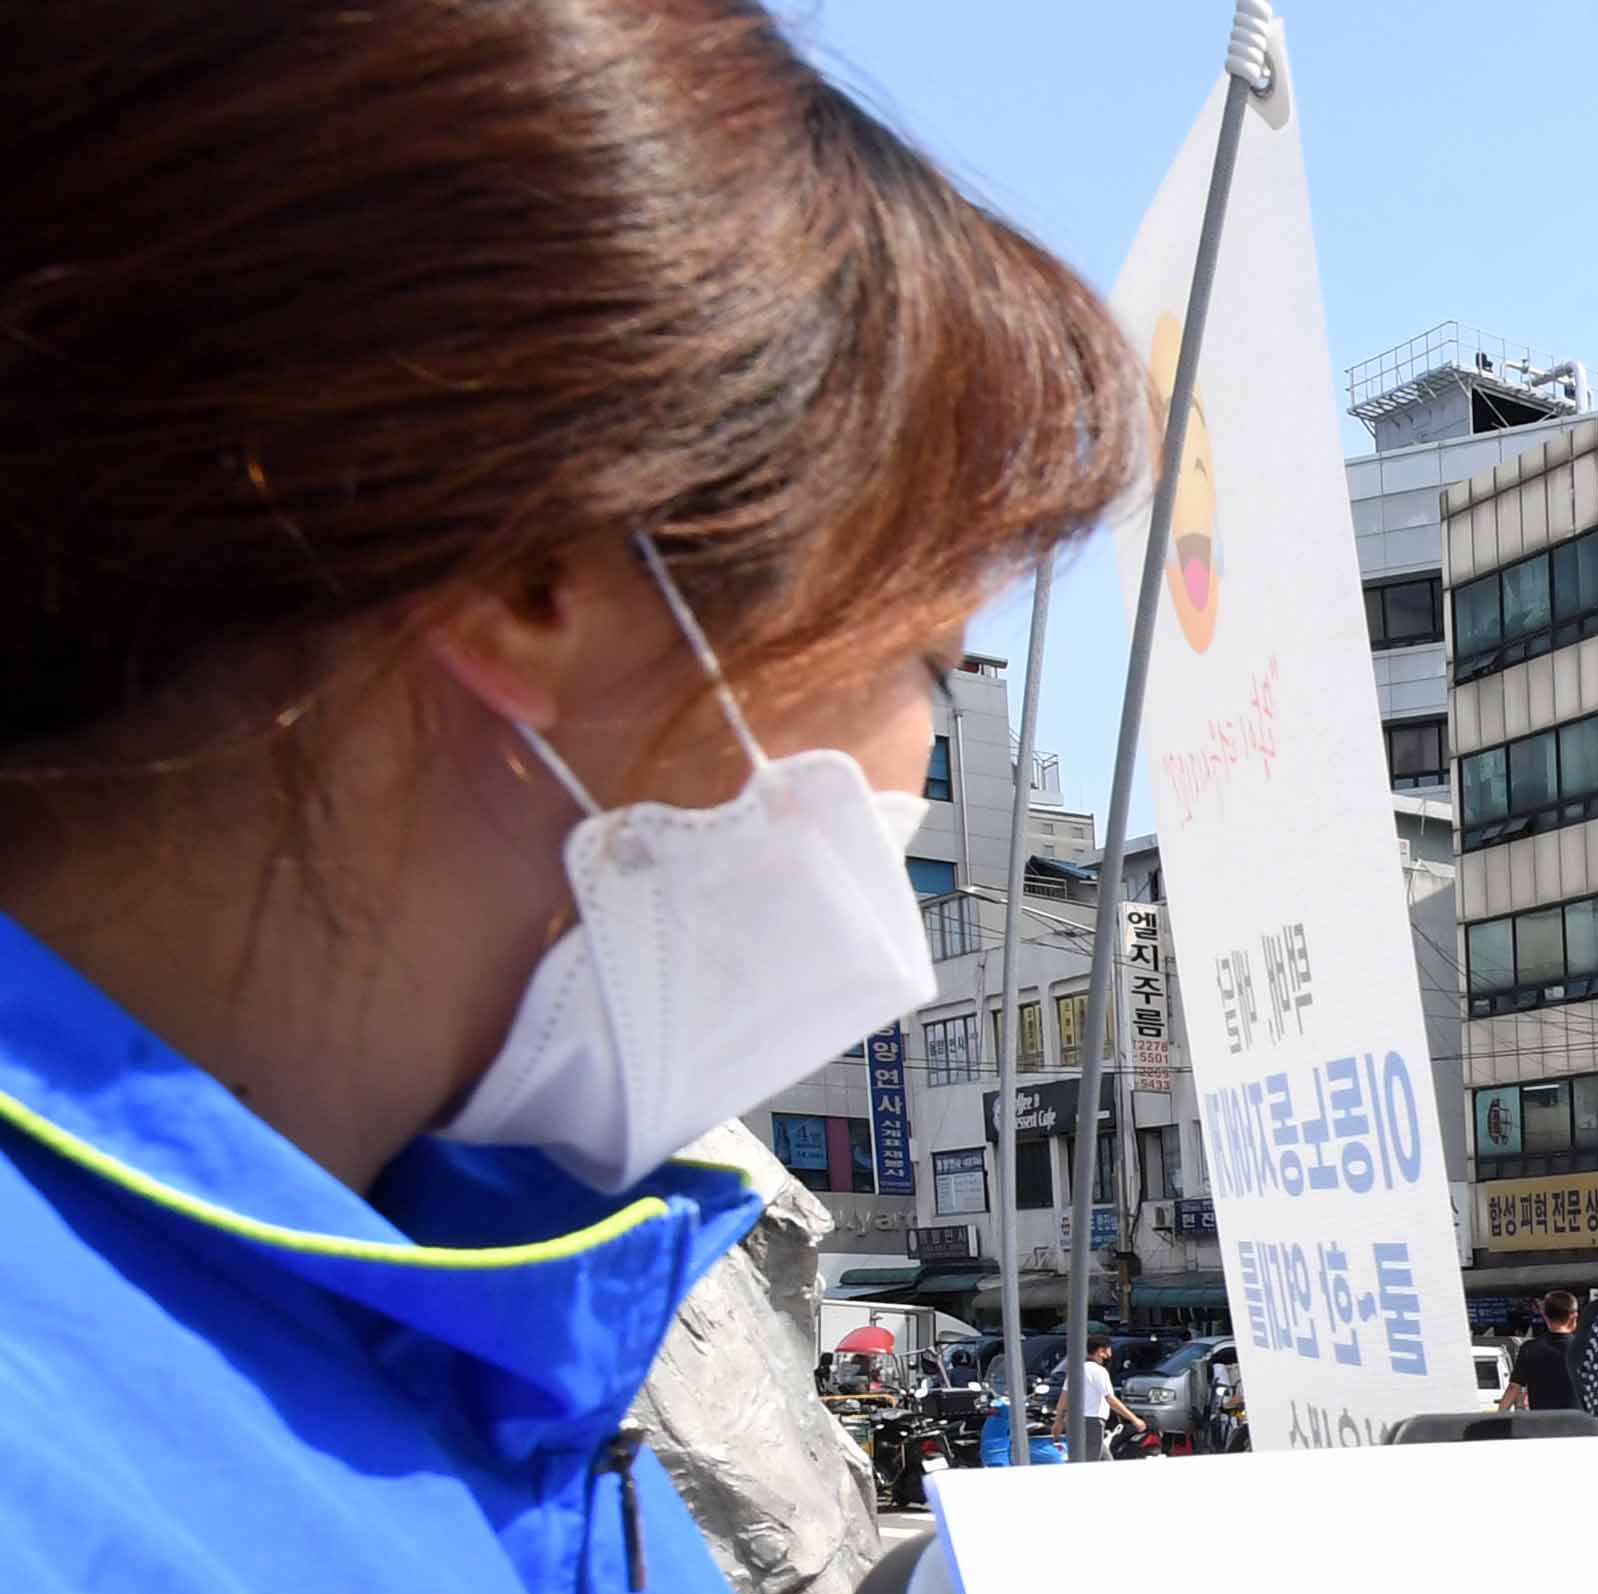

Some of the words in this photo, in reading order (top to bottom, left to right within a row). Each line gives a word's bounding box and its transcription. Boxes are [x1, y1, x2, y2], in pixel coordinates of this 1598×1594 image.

[1128, 912, 1166, 1038] 엘지주름
[1489, 1193, 1517, 1237] 합성
[1520, 1191, 1548, 1235] 피혁
[1552, 1189, 1581, 1233] 전문
